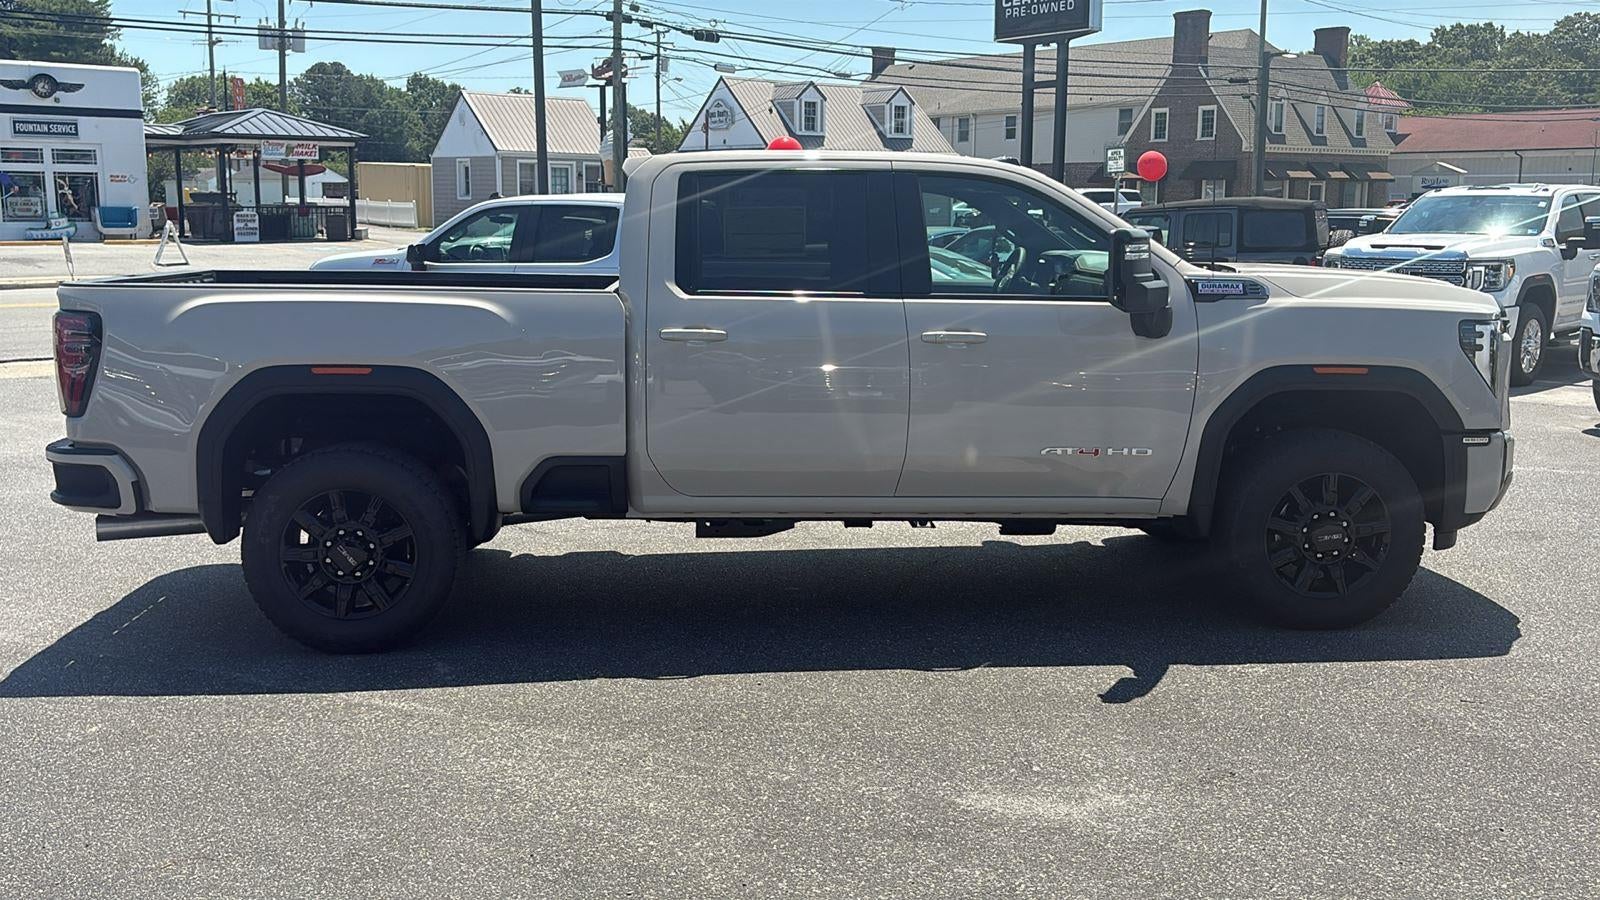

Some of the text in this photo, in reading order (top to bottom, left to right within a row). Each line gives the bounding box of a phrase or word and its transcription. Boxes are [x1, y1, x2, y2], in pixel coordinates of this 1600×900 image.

[1005, 0, 1075, 18] PRE-OWNED
[15, 123, 76, 133] FOUNTAIN SERVICE
[1040, 447, 1152, 457] AT4 HD
